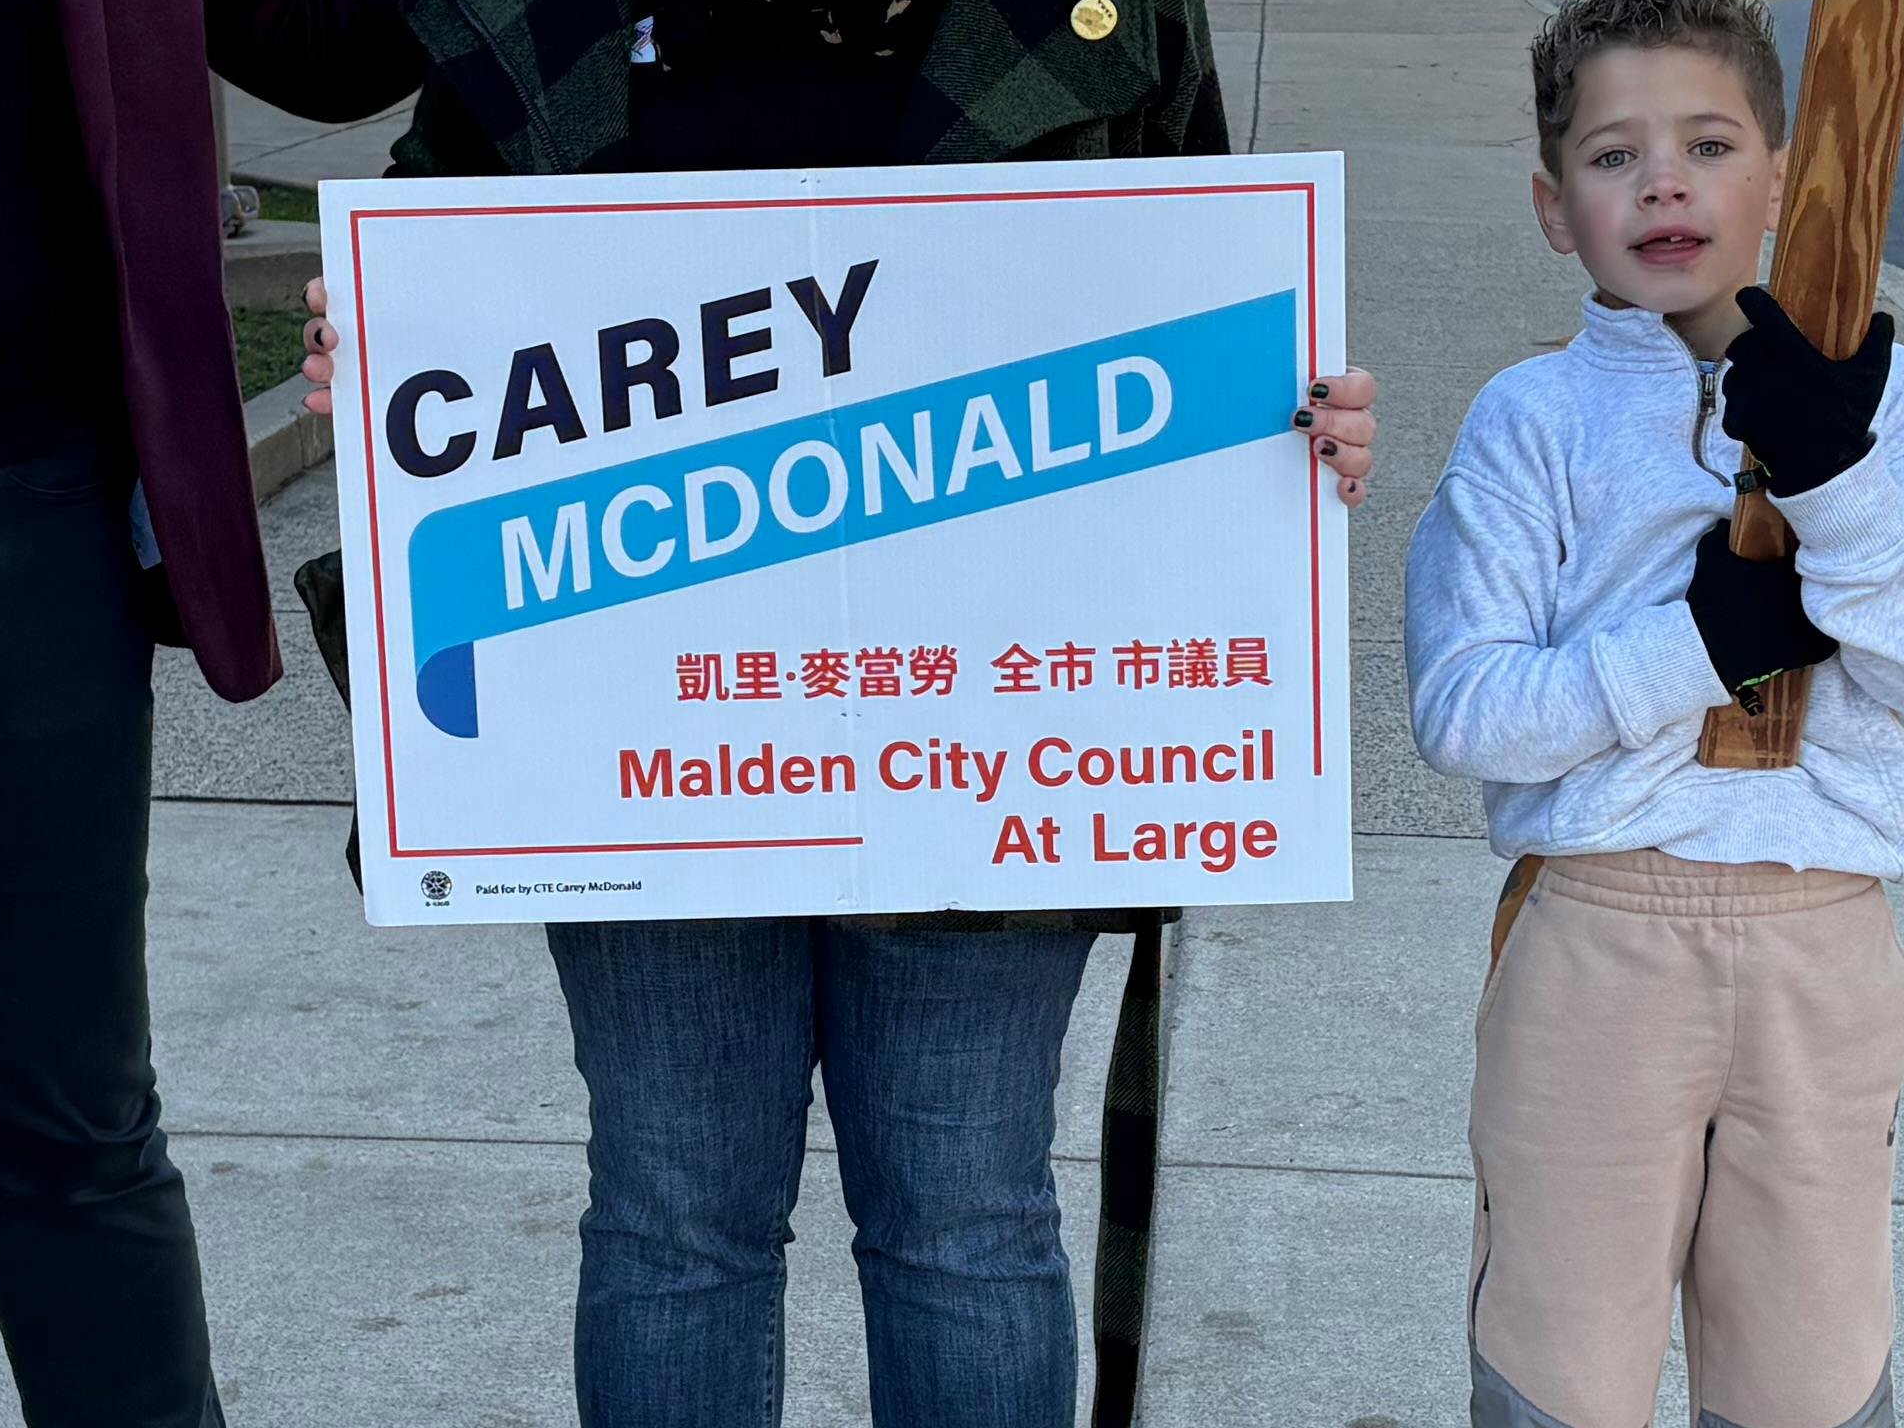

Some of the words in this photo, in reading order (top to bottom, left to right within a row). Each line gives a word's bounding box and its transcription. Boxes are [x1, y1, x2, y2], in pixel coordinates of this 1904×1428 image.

[385, 259, 880, 478] CAREY
[502, 355, 1173, 610] MCDONALD
[990, 641, 1096, 694] 全市
[1112, 637, 1273, 689] 市議員
[619, 743, 857, 800] Malden
[879, 738, 1008, 805] City
[1028, 730, 1275, 788] Council
[992, 815, 1061, 865] At
[1093, 813, 1278, 874] Large
[476, 884, 499, 895] Paid
[501, 883, 516, 894] for
[518, 883, 532, 895] by
[534, 882, 554, 893] CTE
[556, 882, 586, 894] Carey
[588, 880, 643, 892] McDonald
